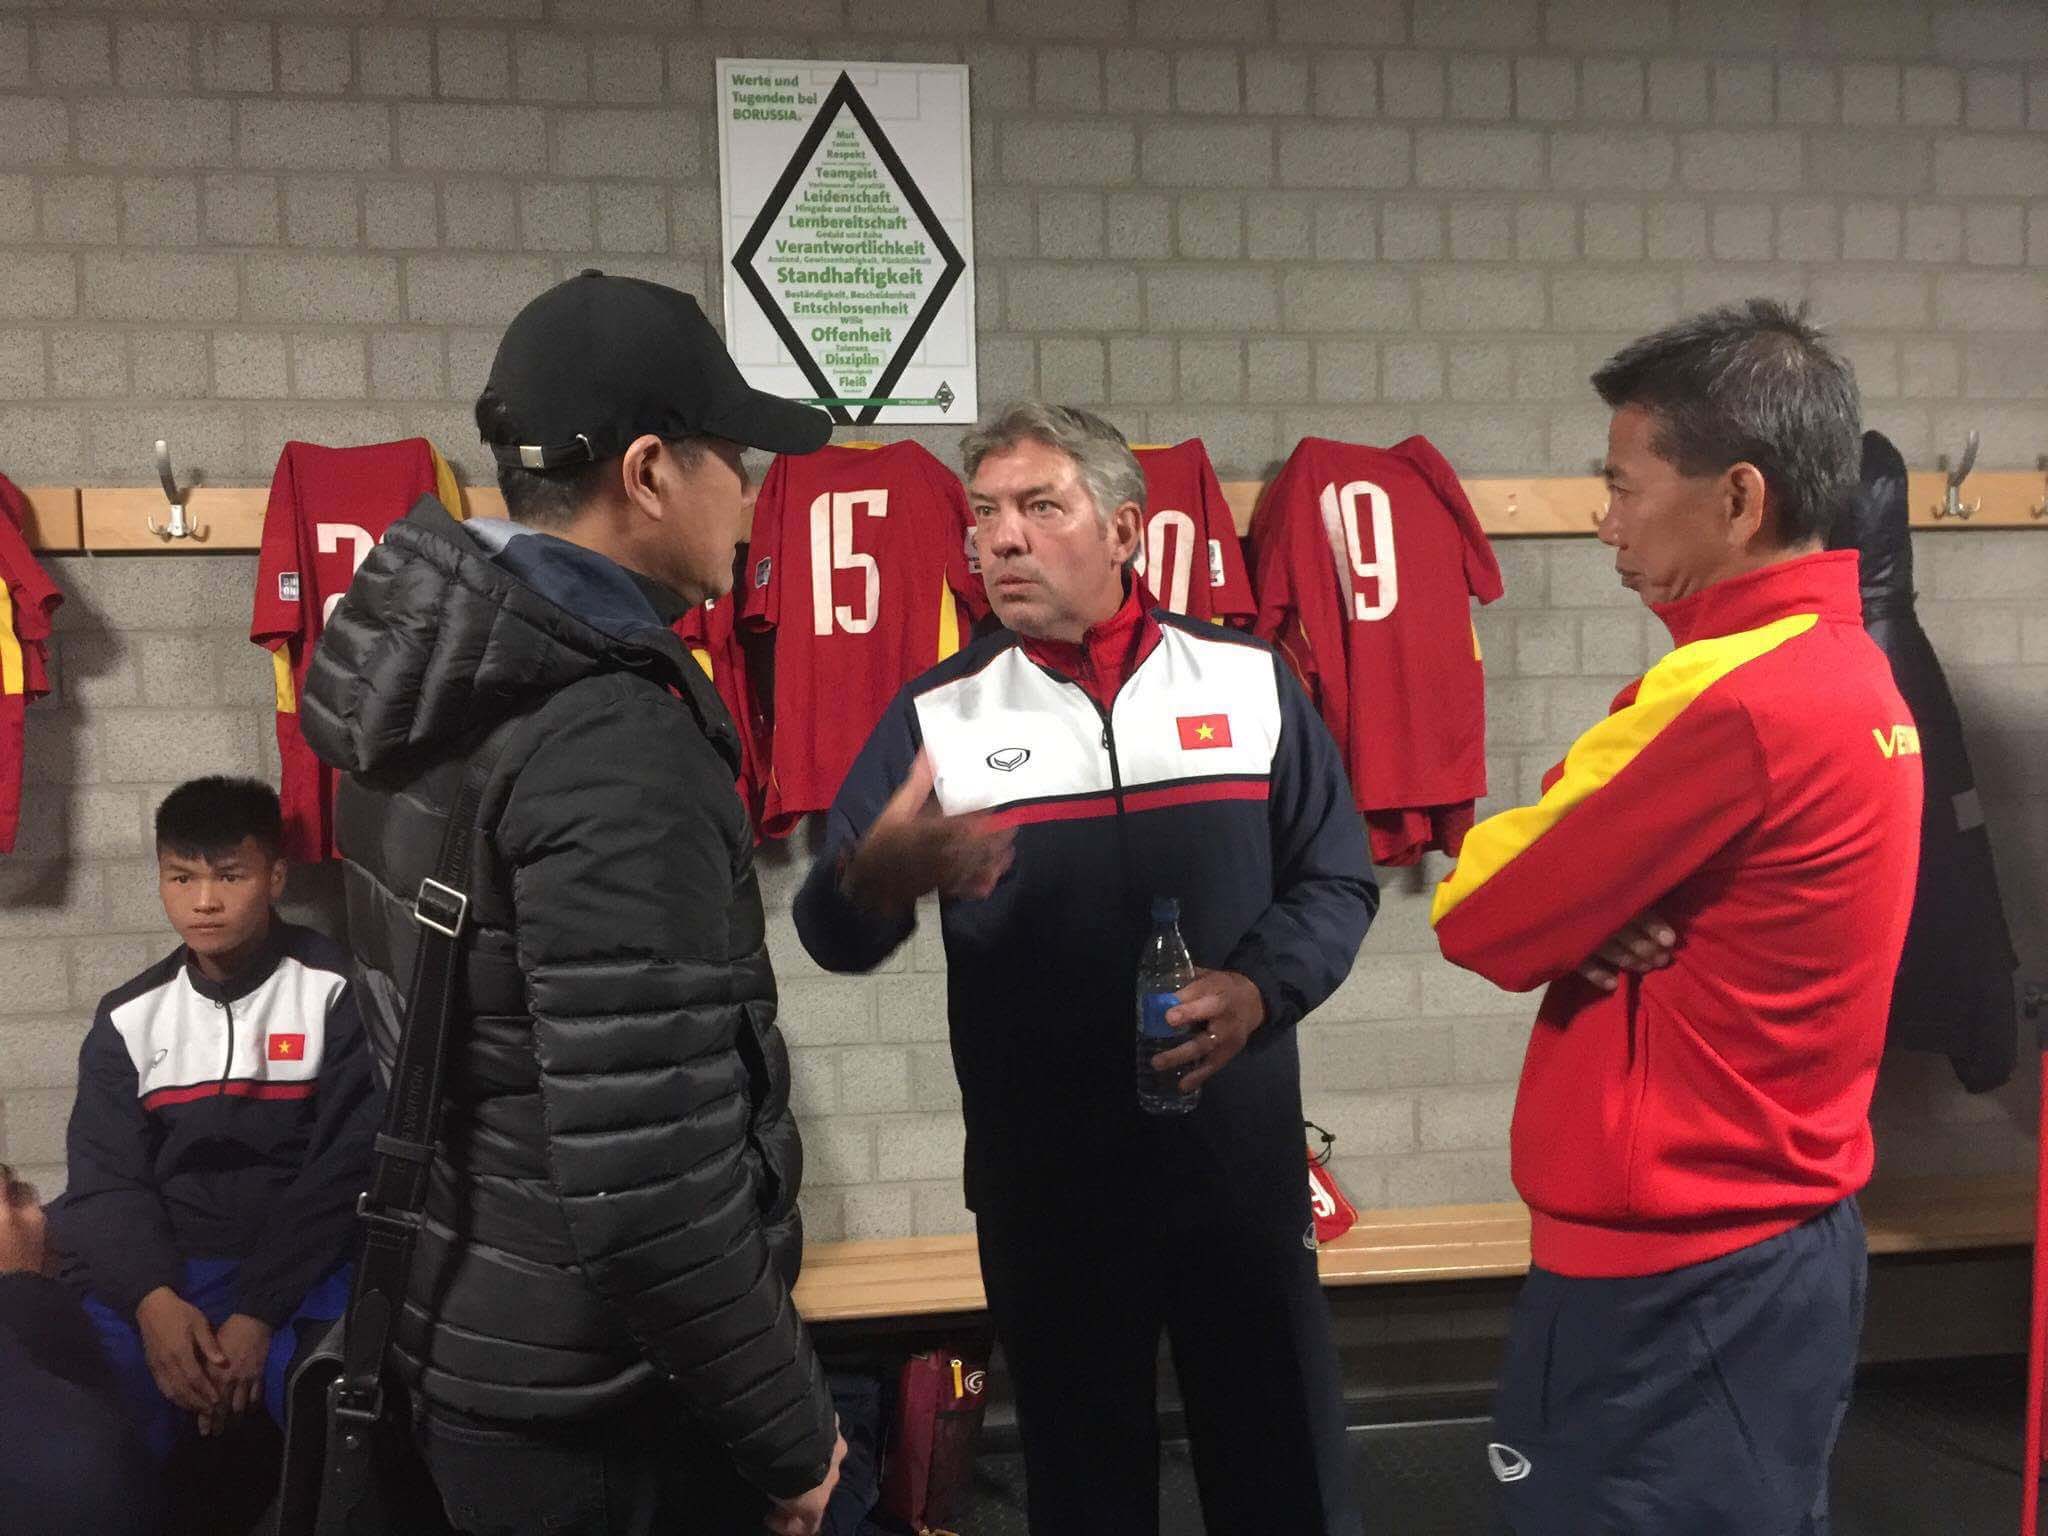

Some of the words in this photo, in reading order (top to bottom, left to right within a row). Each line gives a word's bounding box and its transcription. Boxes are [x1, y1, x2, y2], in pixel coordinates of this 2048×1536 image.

[732, 74, 771, 86] Werte
[775, 75, 799, 87] und
[732, 91, 795, 106] Tugenden
[798, 92, 817, 104] bei
[836, 131, 855, 139] Mut
[827, 150, 866, 160] Respekt
[816, 167, 877, 181] Teamgeist
[804, 190, 890, 203] Leidenschaft
[796, 204, 833, 214] Hingabe
[835, 205, 851, 213] und
[854, 204, 899, 213] Ehrlichkeit
[789, 215, 907, 229] Lernbereitschaft
[776, 240, 925, 255] Verantwortlichkeit
[777, 267, 923, 289] Standhaftigkeit
[851, 291, 916, 299] Bescheidenheit
[793, 301, 909, 314] Entschlossenheit
[811, 326, 892, 342] Offenheit
[825, 353, 880, 367] Disziplin
[839, 376, 867, 387] Fleiß
[1320, 480, 1399, 621] 19
[810, 489, 889, 636] 15
